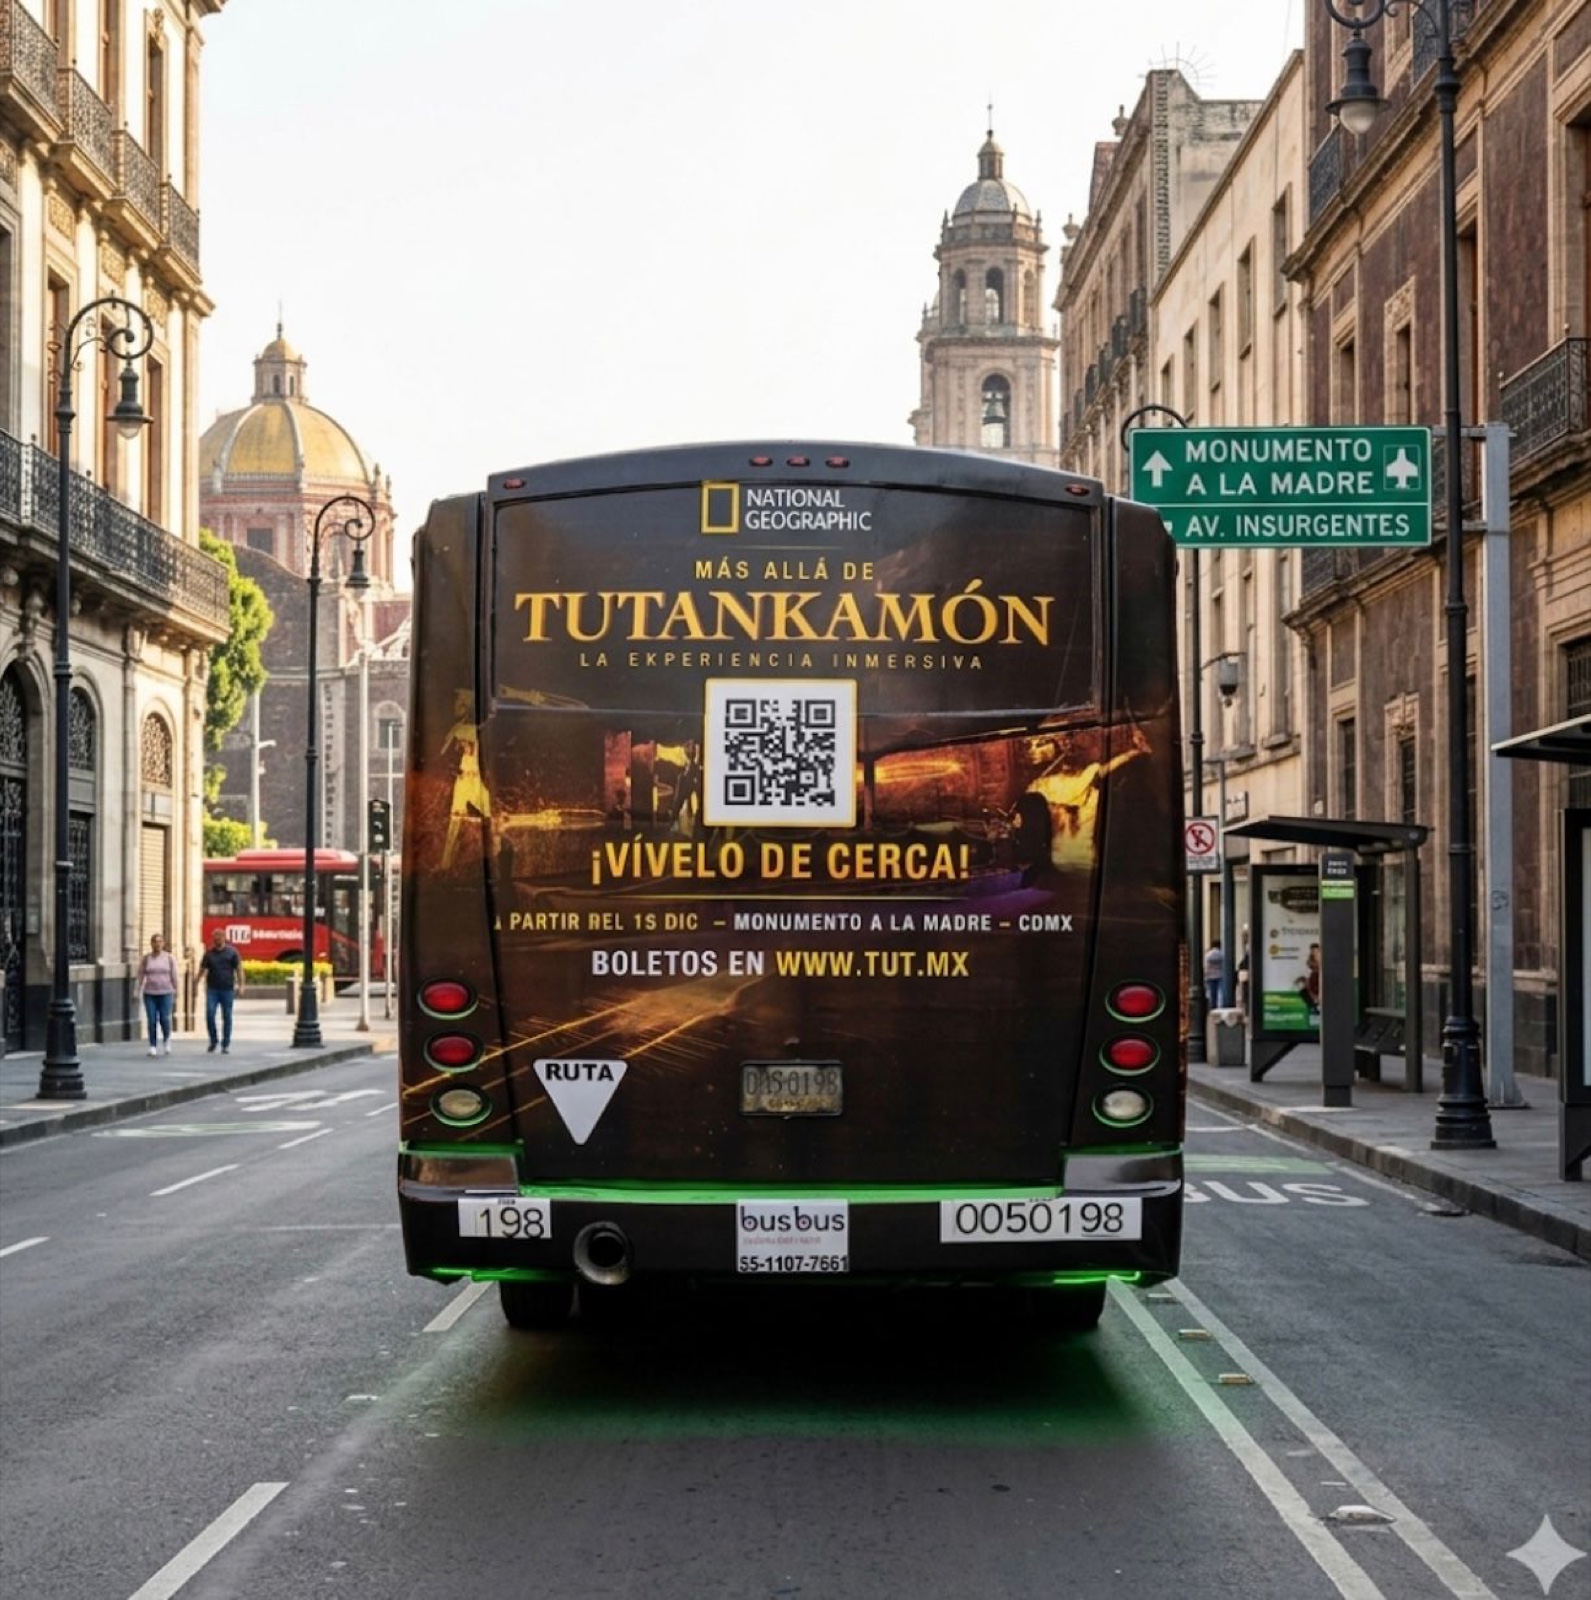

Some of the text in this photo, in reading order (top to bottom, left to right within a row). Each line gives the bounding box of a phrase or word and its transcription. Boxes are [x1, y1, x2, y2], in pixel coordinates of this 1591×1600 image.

[1185, 437, 1372, 463] MONUMENTO
[1186, 471, 1374, 496] A LA MADRE
[747, 488, 845, 508] NATIONAL
[744, 510, 872, 531] GEOGRAPHIC
[1185, 513, 1410, 537] AV. INSURGENTES
[695, 556, 874, 580] MÁS ALLÁ DE
[514, 578, 1056, 646] TUTANKAMÓN
[579, 652, 609, 667] LA
[832, 653, 983, 669] INMERSIVA
[592, 833, 970, 885] ¡VÍVELO DE CERCA!
[509, 912, 580, 931] PARTIR
[664, 912, 698, 931] DIC
[733, 912, 862, 932] MONUMENTO
[870, 913, 882, 932] A
[890, 914, 915, 932] LA
[923, 914, 992, 932] MADRE
[1018, 914, 1073, 933] CDMX
[591, 950, 970, 977] BOLETOS EN WWW.TUT.MX
[545, 1062, 615, 1082] RUTA
[479, 1206, 545, 1238] 198
[955, 1202, 1124, 1235] 0050198
